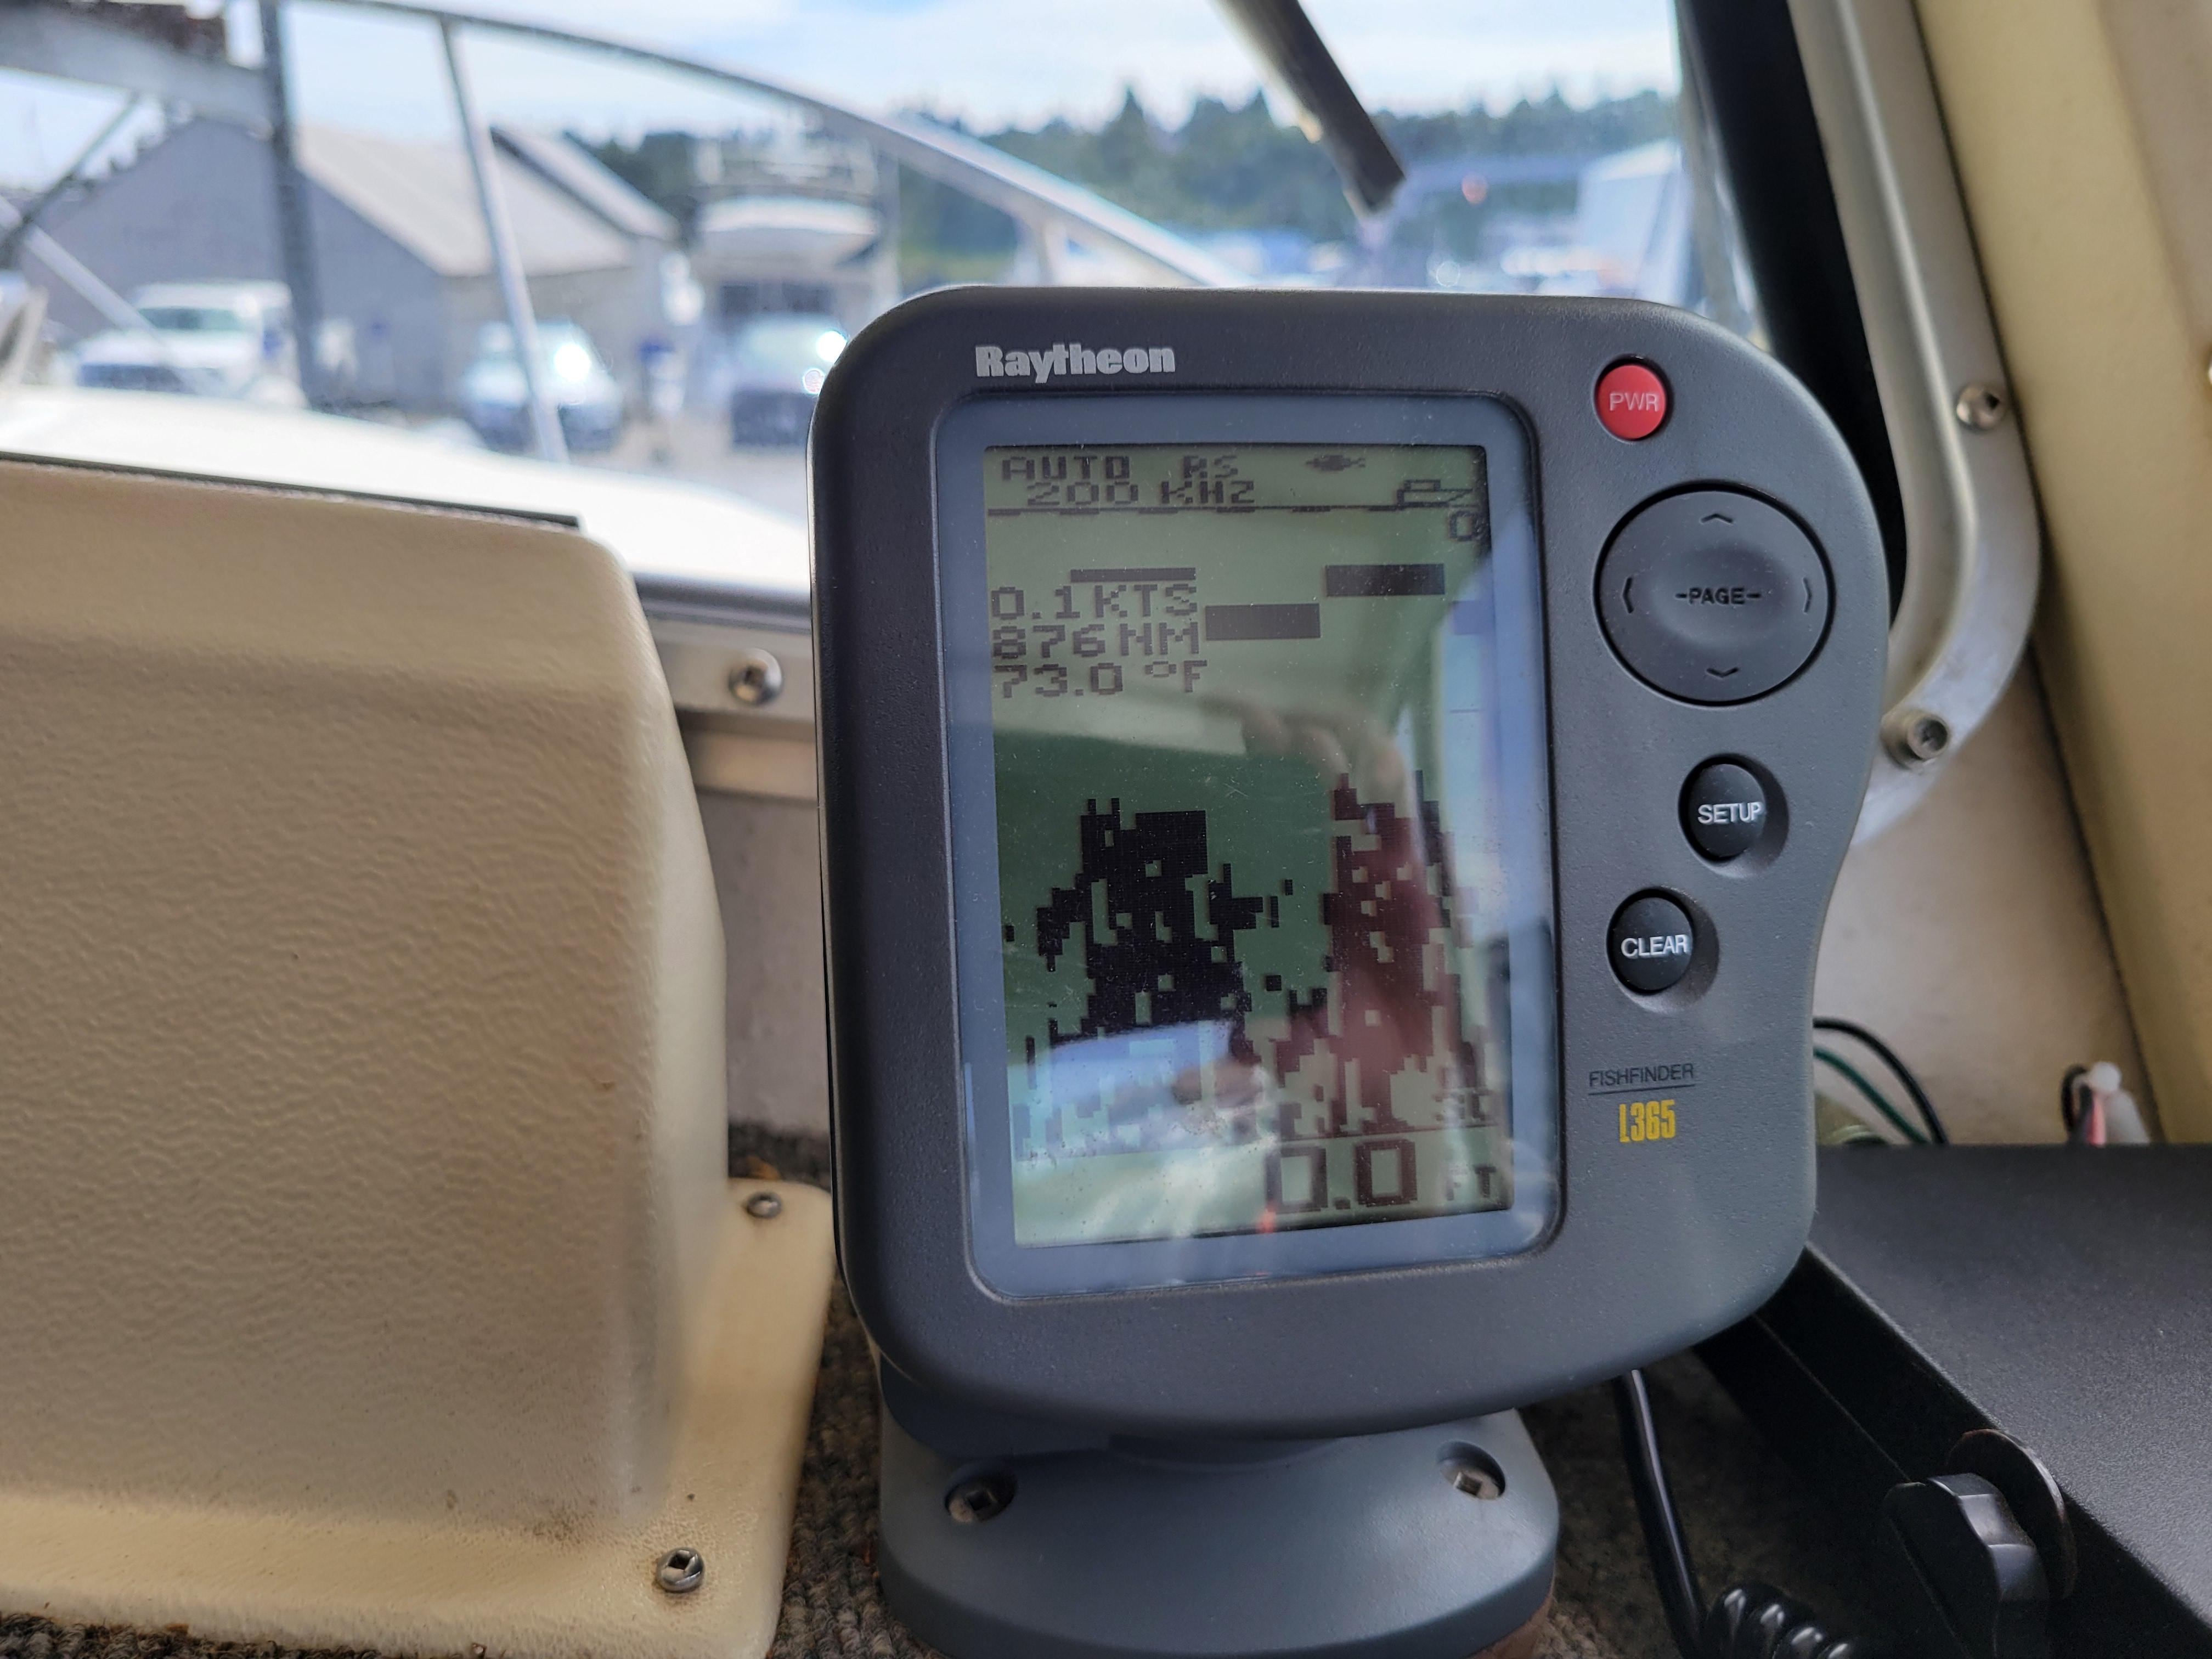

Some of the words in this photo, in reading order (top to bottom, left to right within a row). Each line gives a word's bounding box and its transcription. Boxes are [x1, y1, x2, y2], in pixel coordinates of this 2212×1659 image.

[975, 343, 1175, 383] Raytheon
[1610, 392, 1660, 411] PWR
[1002, 456, 1129, 480] AUTO
[1027, 482, 1138, 506] 200
[1698, 802, 1763, 823] SETUP
[1621, 934, 1691, 958] CLEAR
[1589, 1063, 1694, 1087] FISHFINDER
[1619, 1099, 1676, 1142] L365
[1266, 1139, 1418, 1215] 0.0
